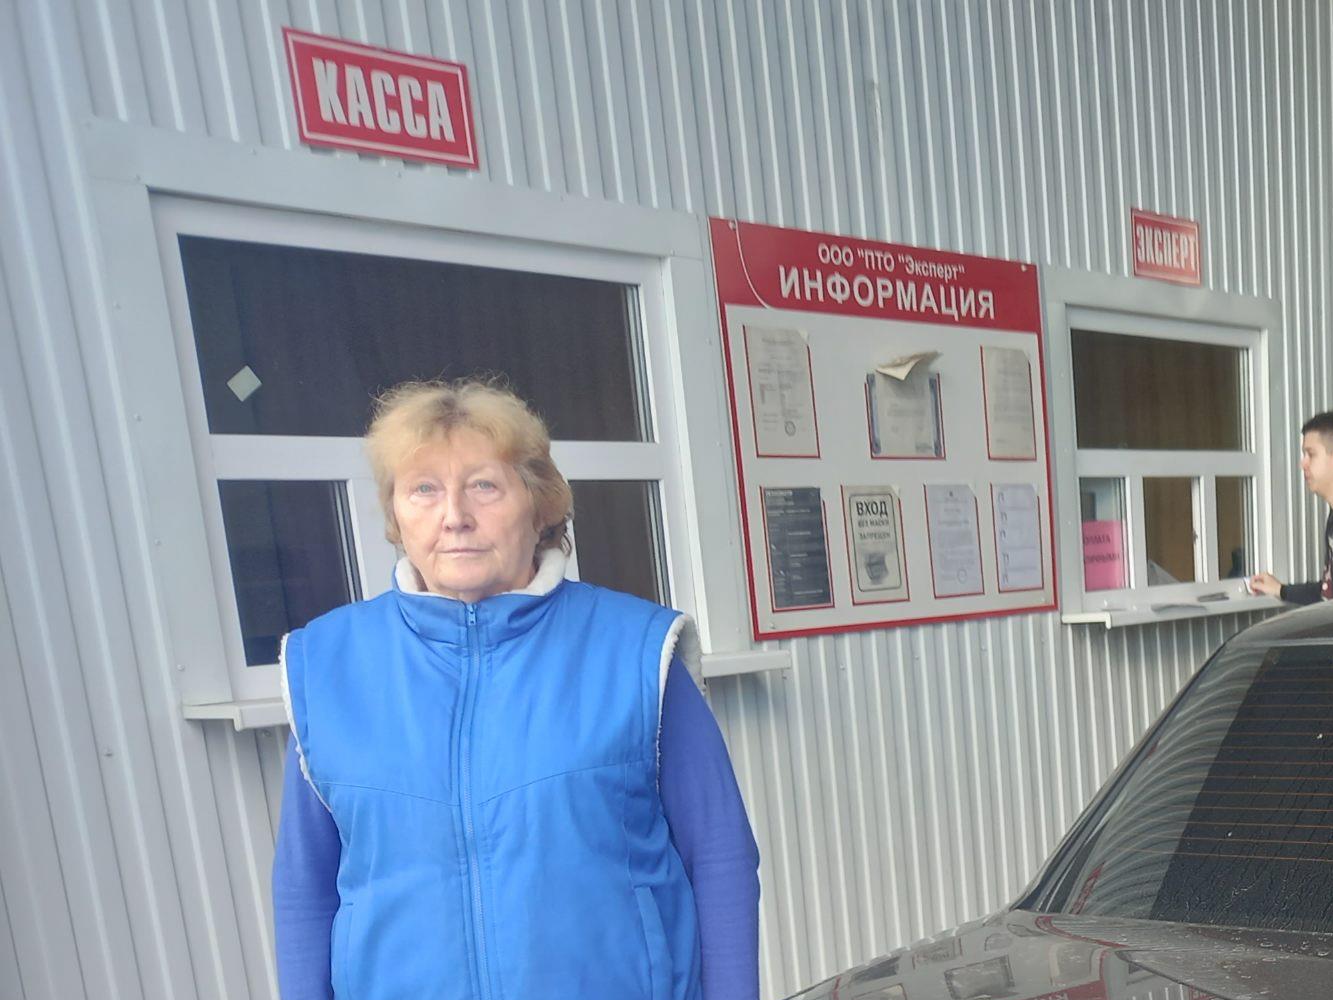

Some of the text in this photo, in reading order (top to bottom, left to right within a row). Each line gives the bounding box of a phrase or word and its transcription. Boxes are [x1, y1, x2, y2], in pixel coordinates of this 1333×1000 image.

[311, 56, 456, 143] КАССА
[817, 242, 854, 267] ООО
[1136, 224, 1197, 272] ЭКСПЕРТ
[778, 264, 996, 322] ИНФОРМАЦИЯ
[855, 500, 889, 518] ВХОД
